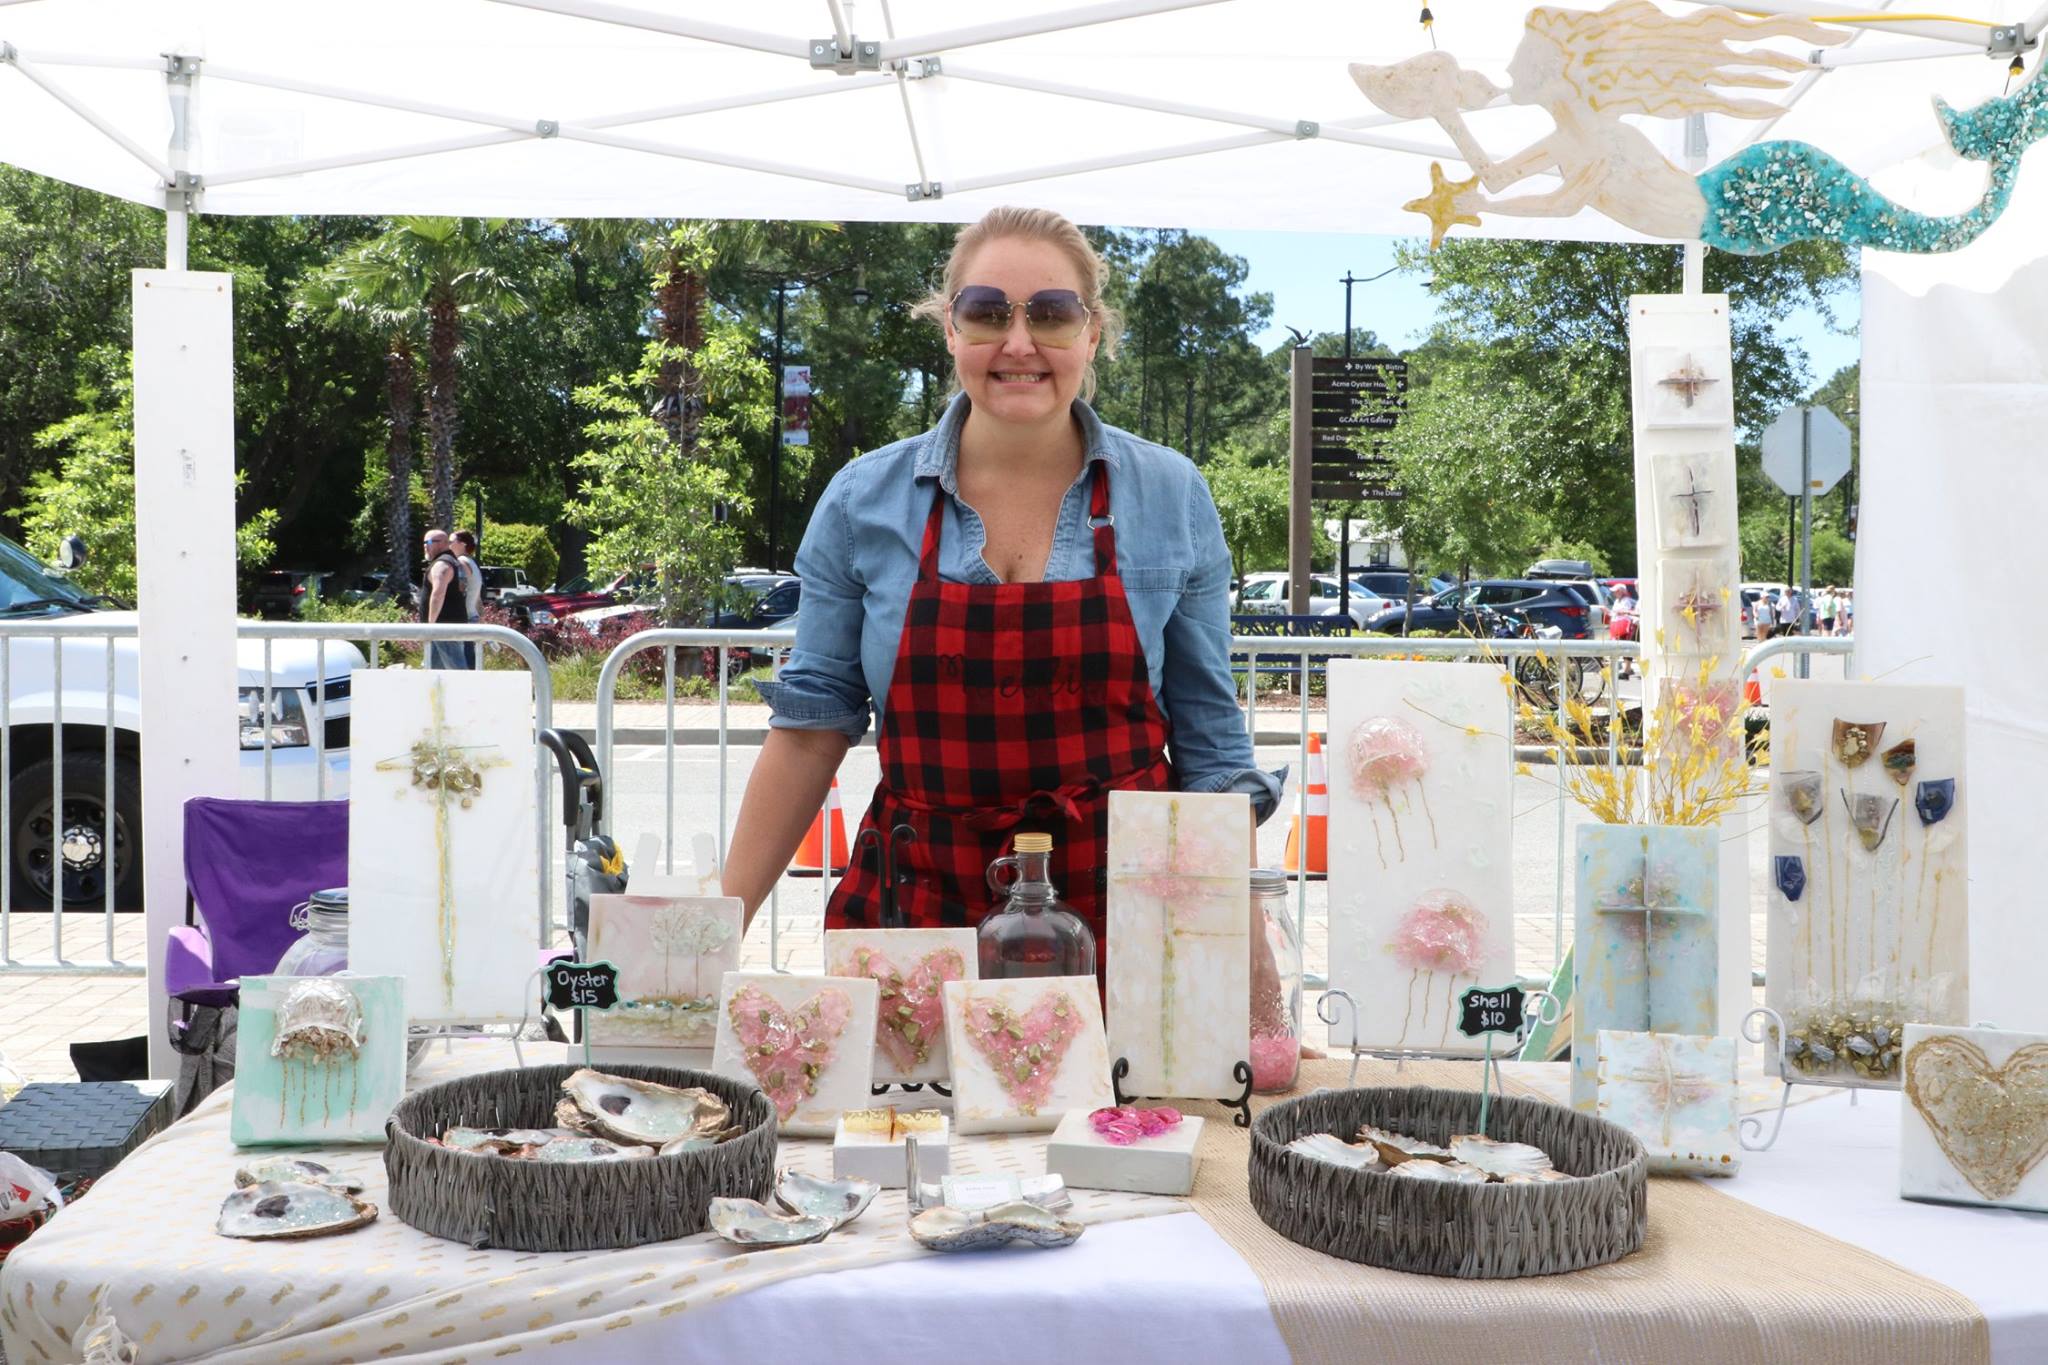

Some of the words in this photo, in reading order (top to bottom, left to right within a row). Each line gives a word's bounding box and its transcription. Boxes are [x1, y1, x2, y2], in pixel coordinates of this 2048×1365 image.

[1354, 363, 1364, 372] By
[1350, 380, 1373, 389] Oyster
[1372, 489, 1384, 497] The
[557, 970, 609, 992] Oyster
[571, 989, 598, 1004] $15
[1480, 1010, 1505, 1027] $10
